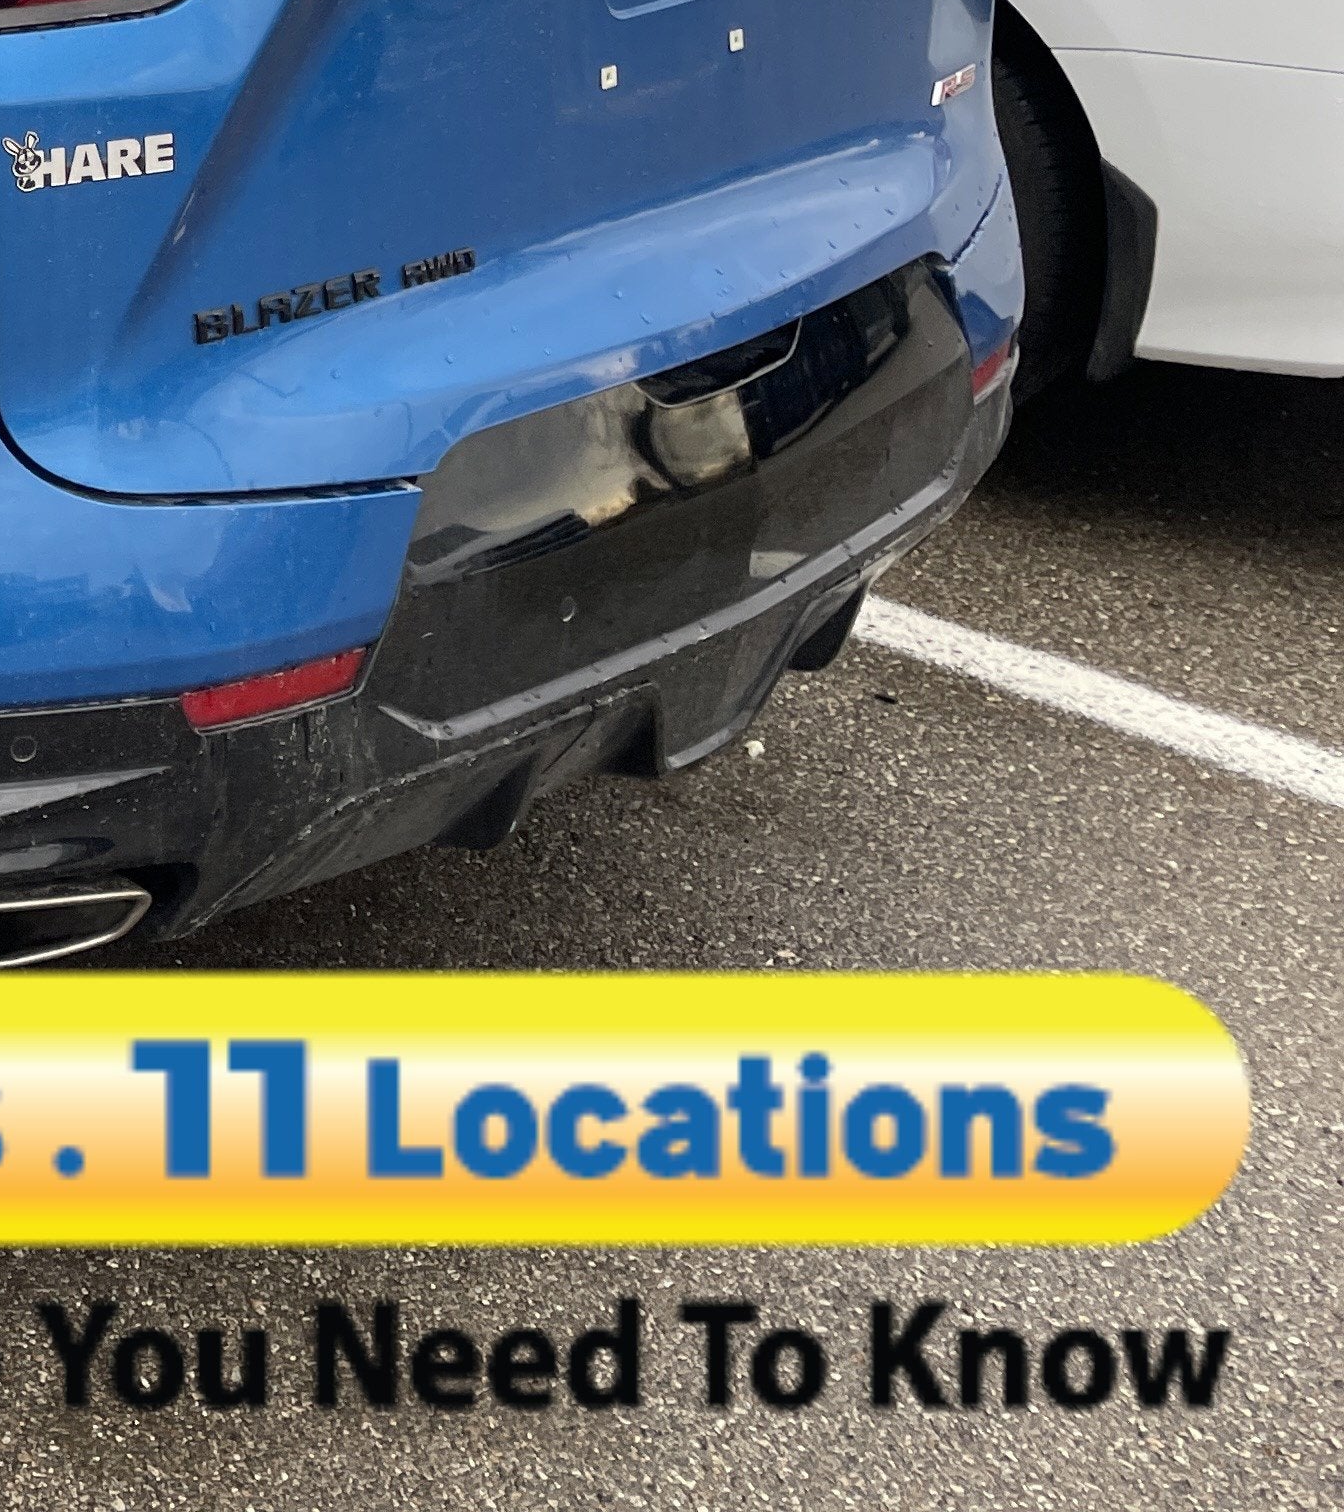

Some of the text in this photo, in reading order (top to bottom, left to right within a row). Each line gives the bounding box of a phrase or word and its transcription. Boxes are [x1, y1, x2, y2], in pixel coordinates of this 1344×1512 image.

[28, 132, 175, 189] HARE
[193, 246, 477, 346] BLAZER AWD
